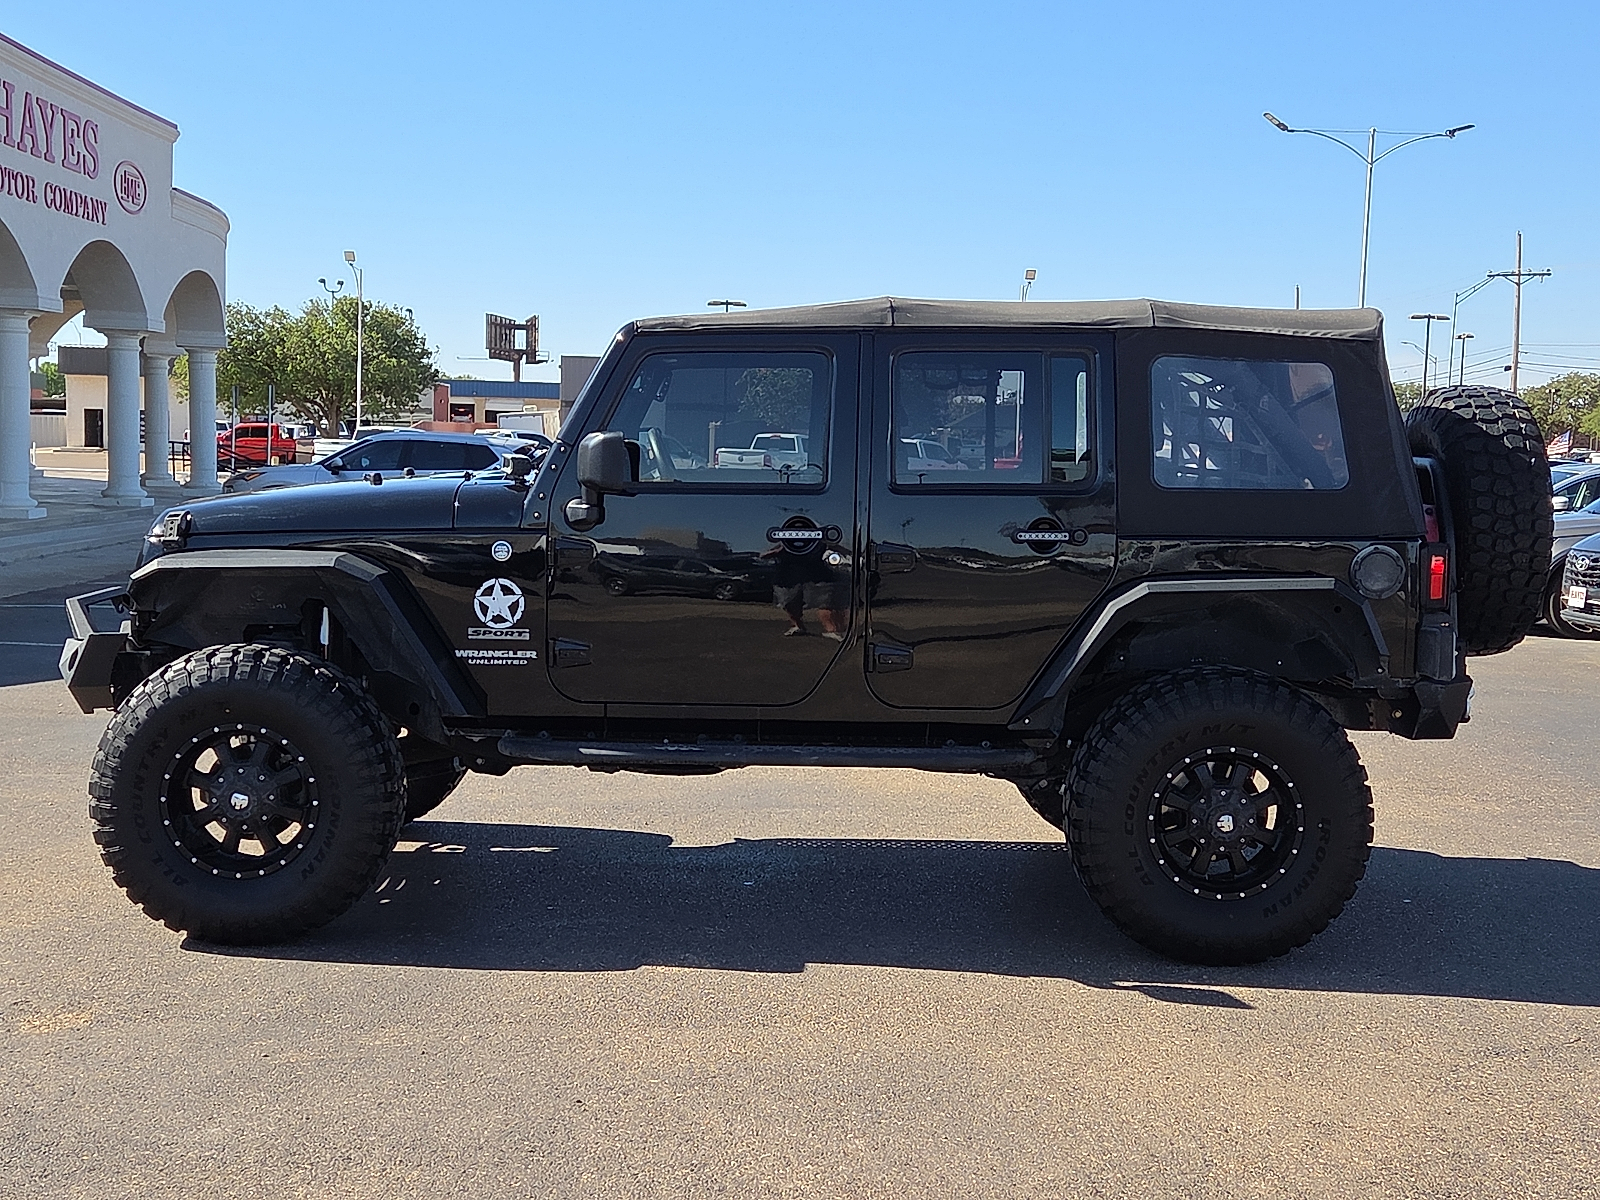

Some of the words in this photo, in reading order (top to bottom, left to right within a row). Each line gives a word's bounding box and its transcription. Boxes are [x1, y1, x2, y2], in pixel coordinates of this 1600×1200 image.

[44, 182, 108, 226] COMPANY
[455, 649, 537, 658] WRANGLER
[469, 629, 528, 638] SPORT
[1202, 723, 1256, 735] M/T
[133, 727, 168, 844] COUNTRY
[1125, 731, 1190, 835] COUNTRY
[1128, 844, 1154, 885] ALL
[1263, 817, 1331, 917] IRONMAN
